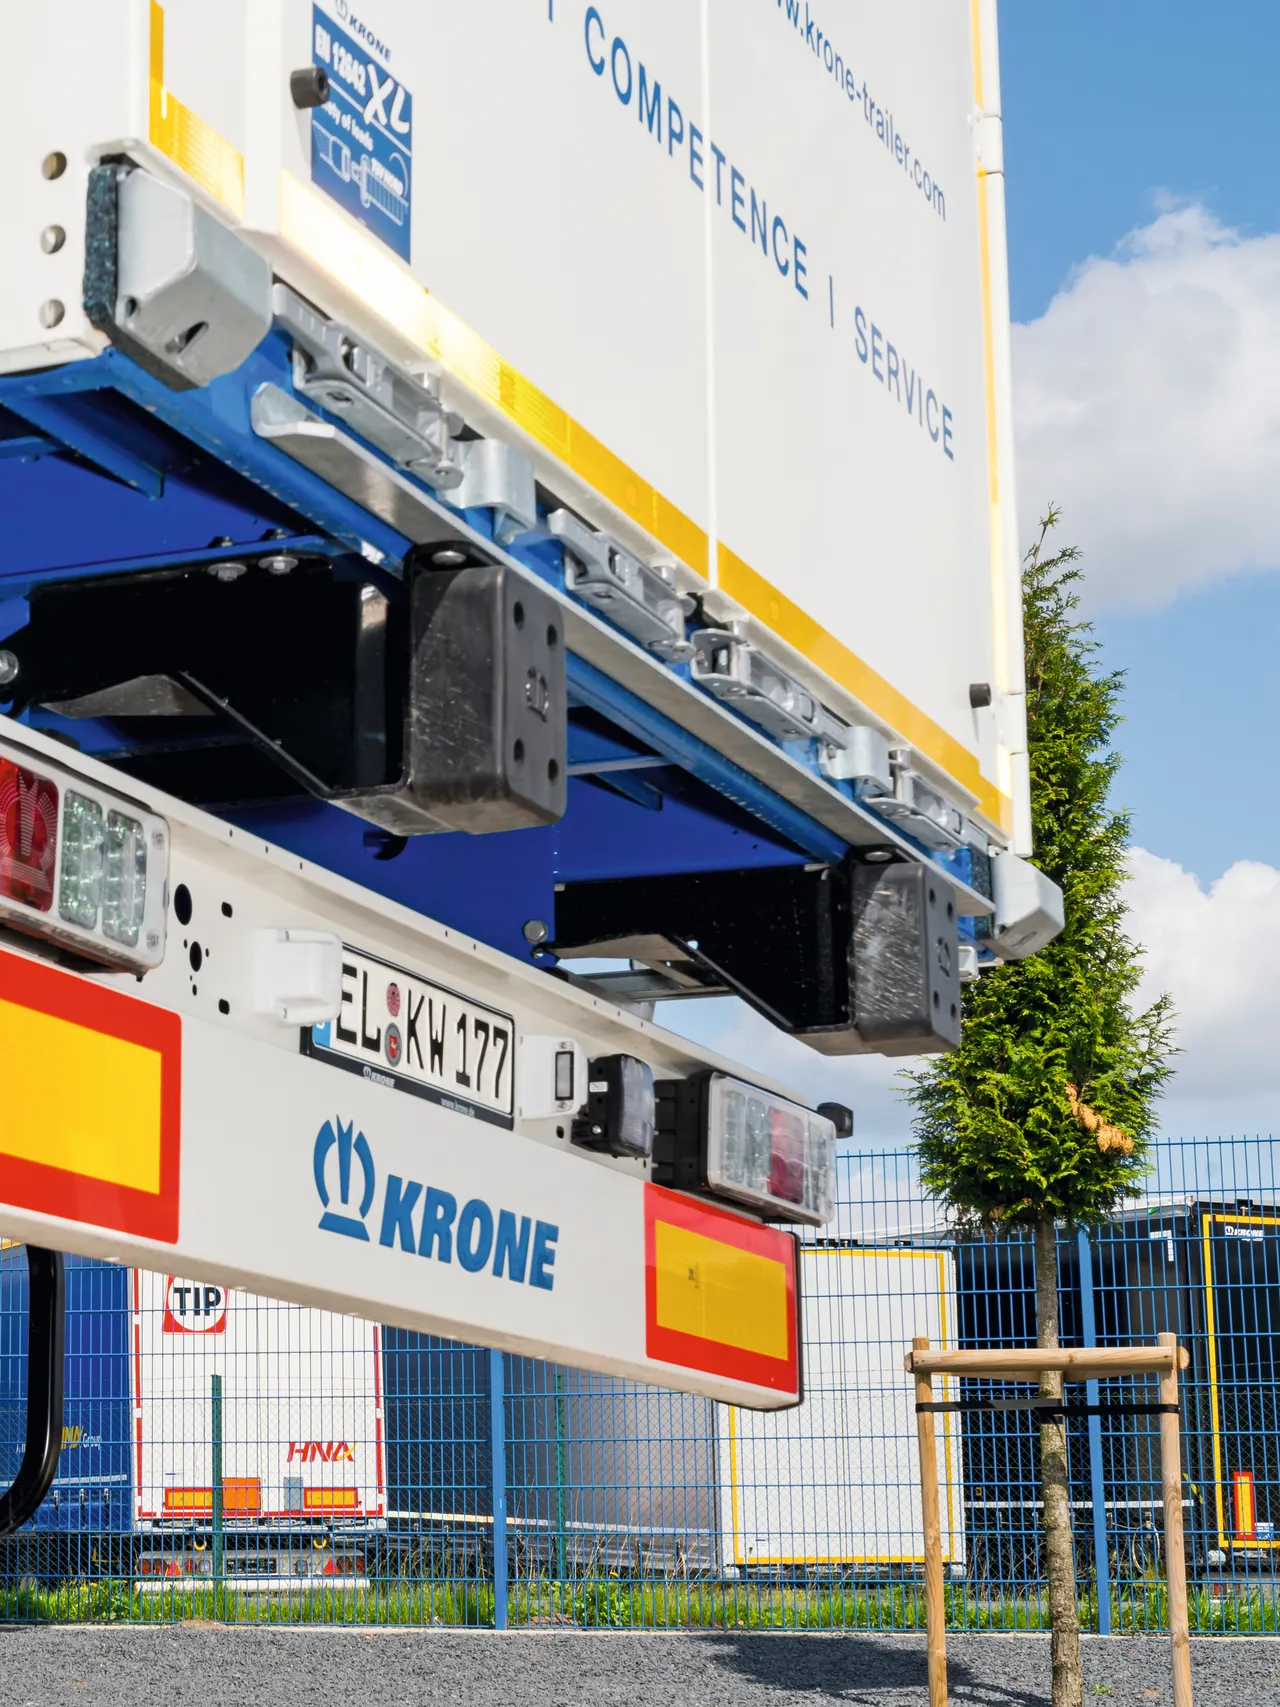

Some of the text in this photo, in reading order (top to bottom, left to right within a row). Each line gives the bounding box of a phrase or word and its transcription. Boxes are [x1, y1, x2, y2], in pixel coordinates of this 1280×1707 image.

[349, 15, 391, 61] KRONE
[363, 62, 410, 133] XL
[584, 6, 808, 301] COMPETENCE
[854, 305, 954, 461] SERVICE
[407, 988, 447, 1077] KW
[455, 1013, 509, 1099] 177
[379, 1174, 560, 1291] KRONE
[173, 1287, 222, 1316] TIP
